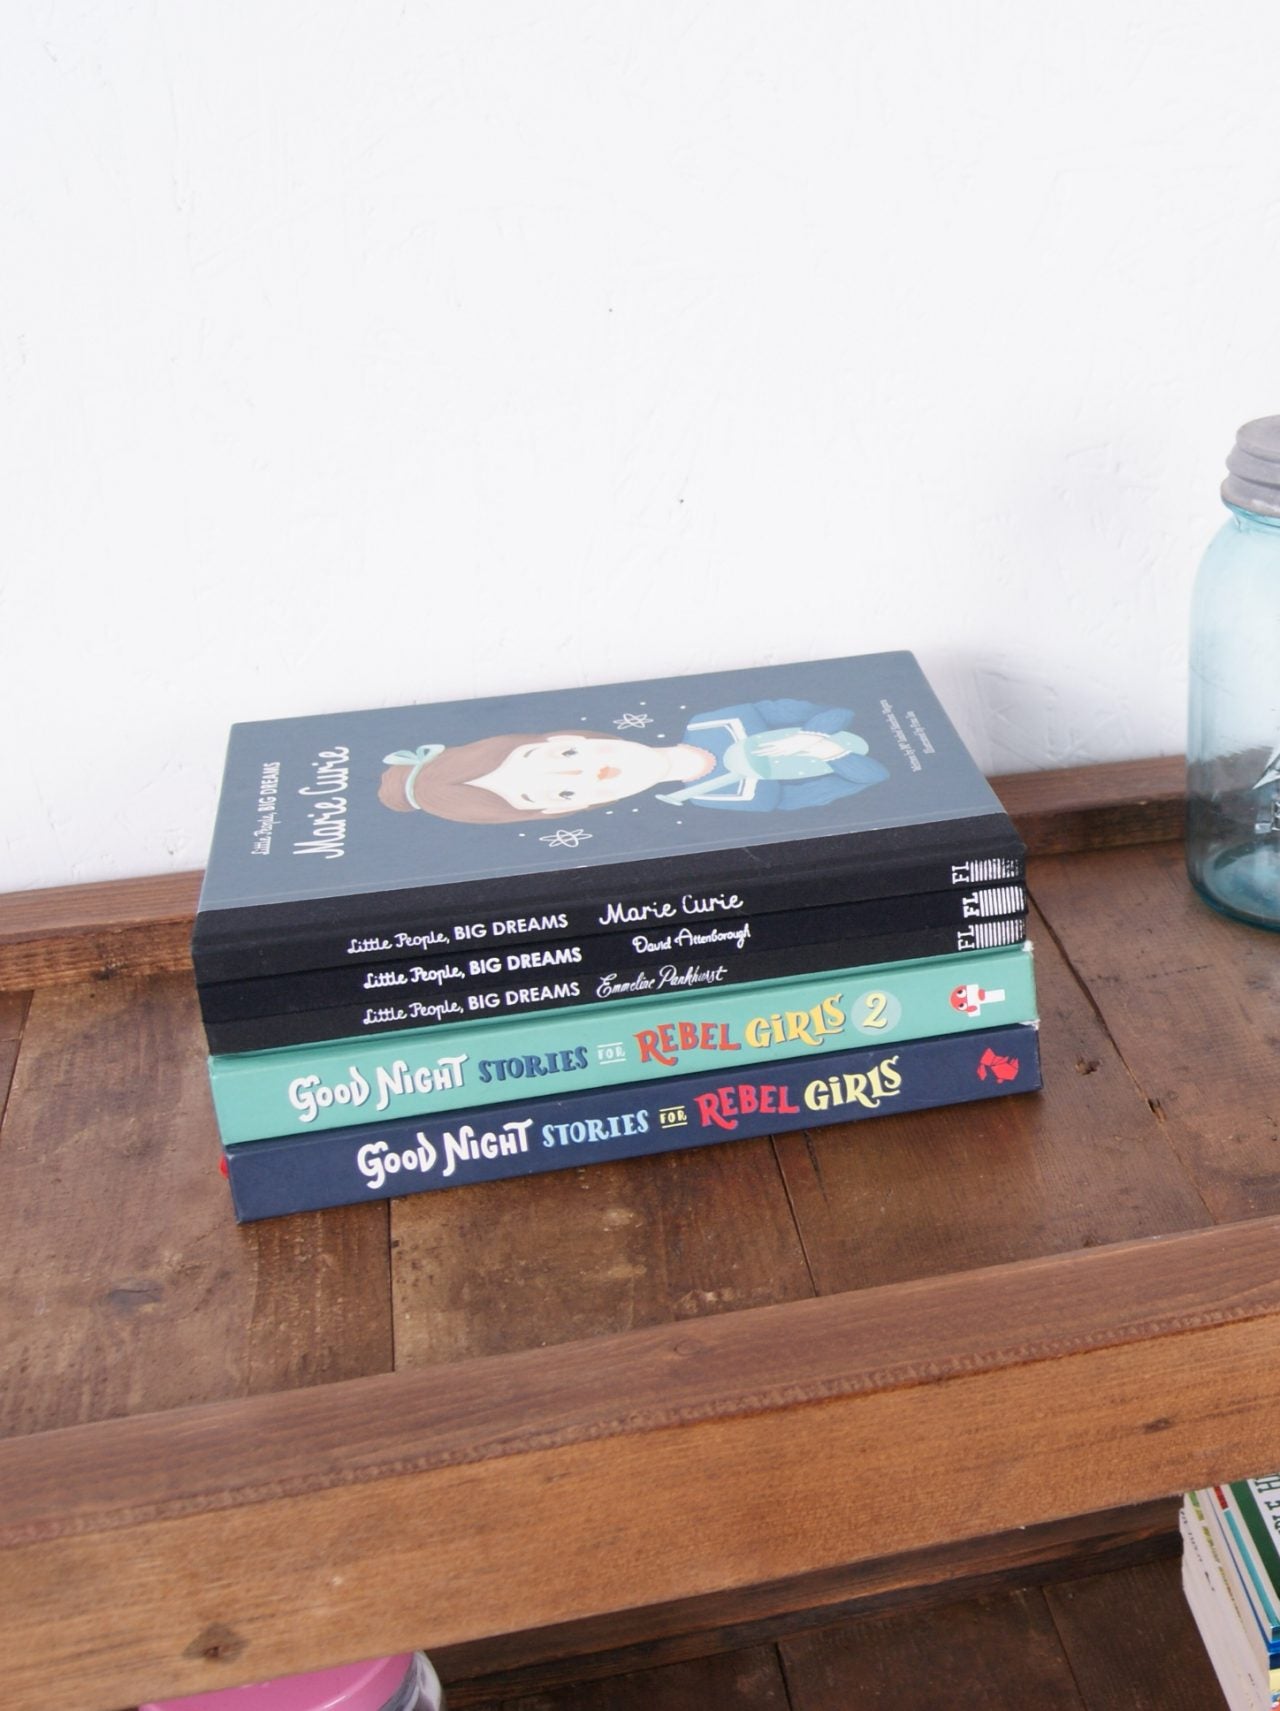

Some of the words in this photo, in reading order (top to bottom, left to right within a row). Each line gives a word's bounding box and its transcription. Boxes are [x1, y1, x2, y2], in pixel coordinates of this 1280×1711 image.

[260, 761, 281, 795] DREAMS
[298, 746, 350, 795] Curie
[257, 797, 277, 811] BIG
[293, 797, 347, 859] Marie
[251, 836, 271, 856] Little
[347, 938, 394, 954] Little
[394, 931, 451, 951] People,
[454, 924, 487, 941] BIG
[492, 913, 569, 937] DREAMS
[599, 902, 677, 925] Marie
[681, 893, 744, 915] Curie
[363, 972, 408, 989] Little
[409, 964, 466, 986] People,
[469, 957, 502, 976] BIG
[507, 947, 583, 971] DREAMS
[632, 935, 672, 953] David
[674, 922, 752, 949] Attenborough
[363, 1009, 407, 1025] Little
[409, 1000, 465, 1021] People,
[468, 993, 501, 1011] BIG
[505, 982, 581, 1006] DREAMS
[596, 972, 656, 998] Emmeline
[656, 964, 729, 990] Pankhurst
[478, 1046, 589, 1083] STORIES
[597, 1044, 626, 1062] FOR
[632, 1021, 742, 1067] REBEL
[863, 992, 889, 1030] 2
[542, 1108, 649, 1148] STORIES
[659, 1108, 688, 1126] FOR
[693, 1084, 801, 1130] REBEL
